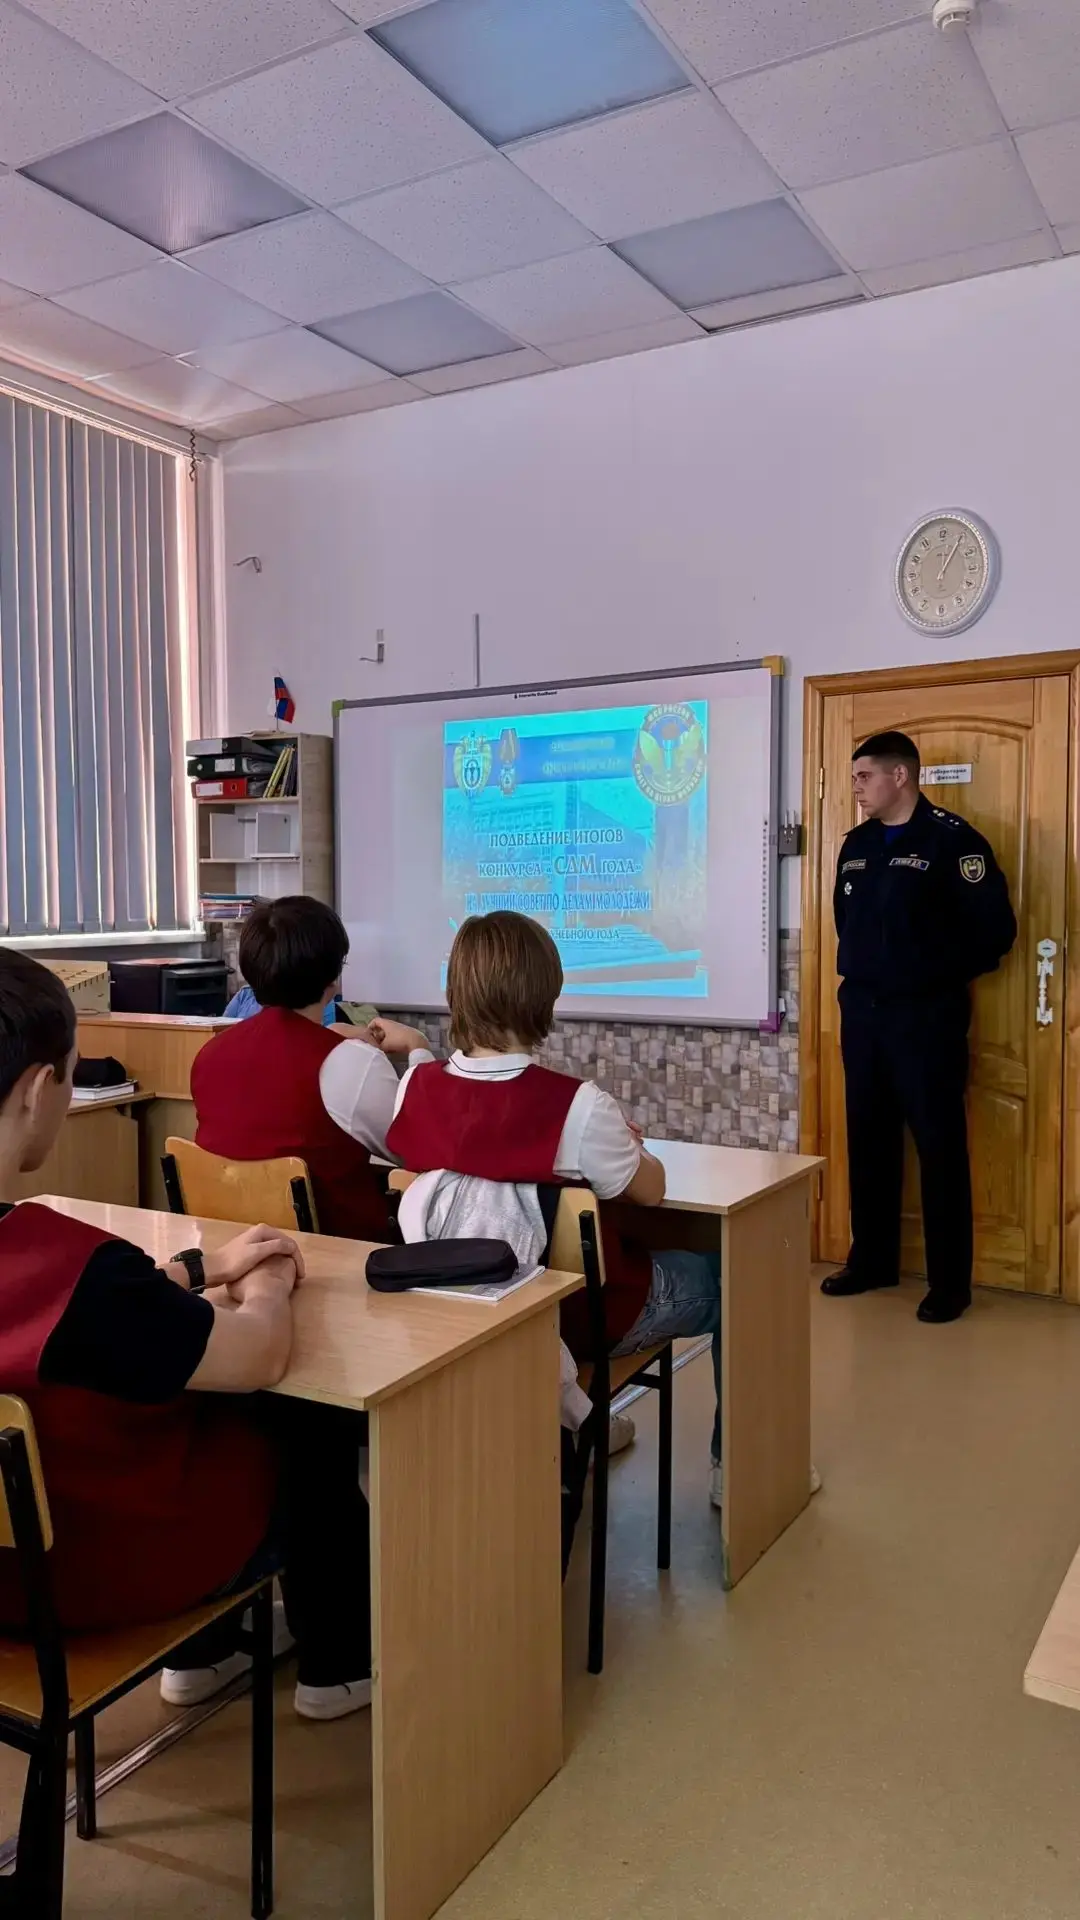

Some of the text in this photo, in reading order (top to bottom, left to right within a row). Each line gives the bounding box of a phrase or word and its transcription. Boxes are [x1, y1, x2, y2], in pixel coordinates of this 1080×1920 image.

[489, 829, 623, 847] ПОДВЕДЕНИЕ ИТОГОВ
[479, 862, 542, 877] КОНКУРСА
[596, 928, 620, 939] ГОДА
